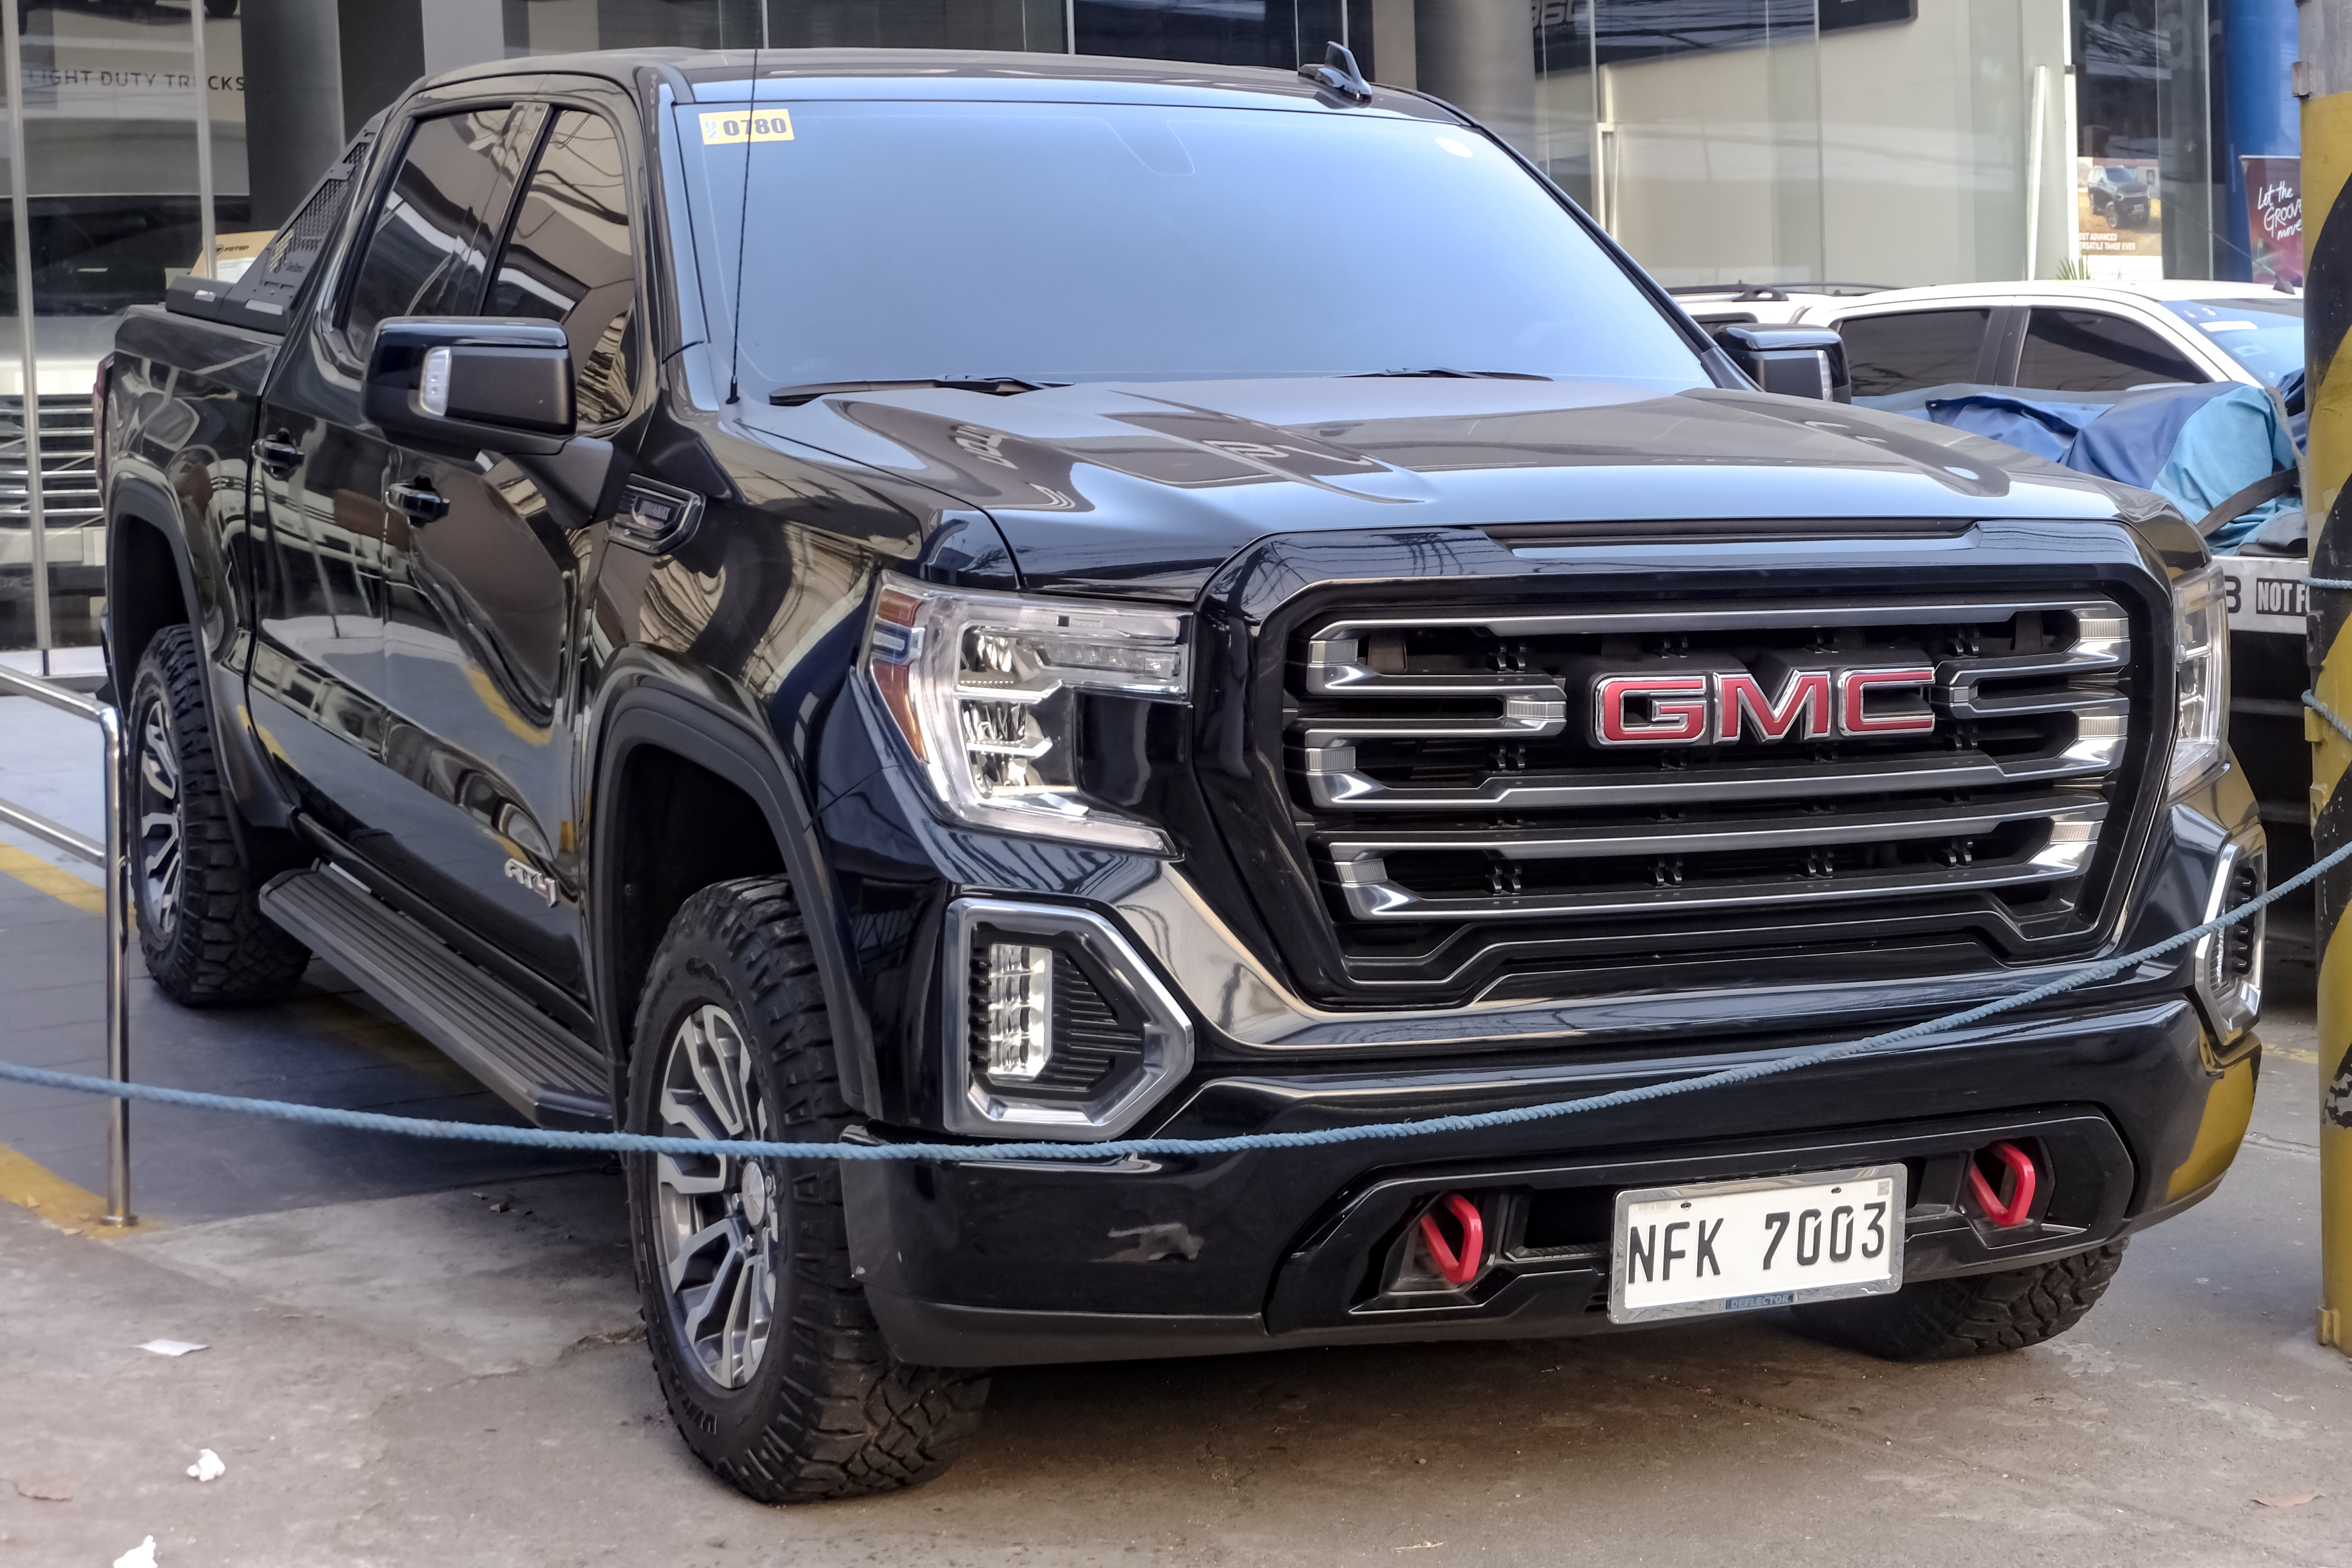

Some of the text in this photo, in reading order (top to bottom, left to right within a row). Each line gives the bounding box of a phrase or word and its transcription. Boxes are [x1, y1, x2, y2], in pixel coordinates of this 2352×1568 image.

[29, 69, 244, 91] LIGHT DUTY TRCKS
[723, 118, 787, 136] 0780
[2257, 180, 2293, 211] Let the
[2090, 233, 2118, 241] ADVANCED
[2277, 218, 2302, 241] move
[2122, 242, 2136, 250] EVER
[2258, 581, 2293, 612] NOT
[1595, 666, 1936, 746] GMC
[504, 858, 557, 908] AT4
[1628, 1200, 1887, 1284] NFK 7003
[1731, 1294, 1789, 1309] DEFLECTOR
